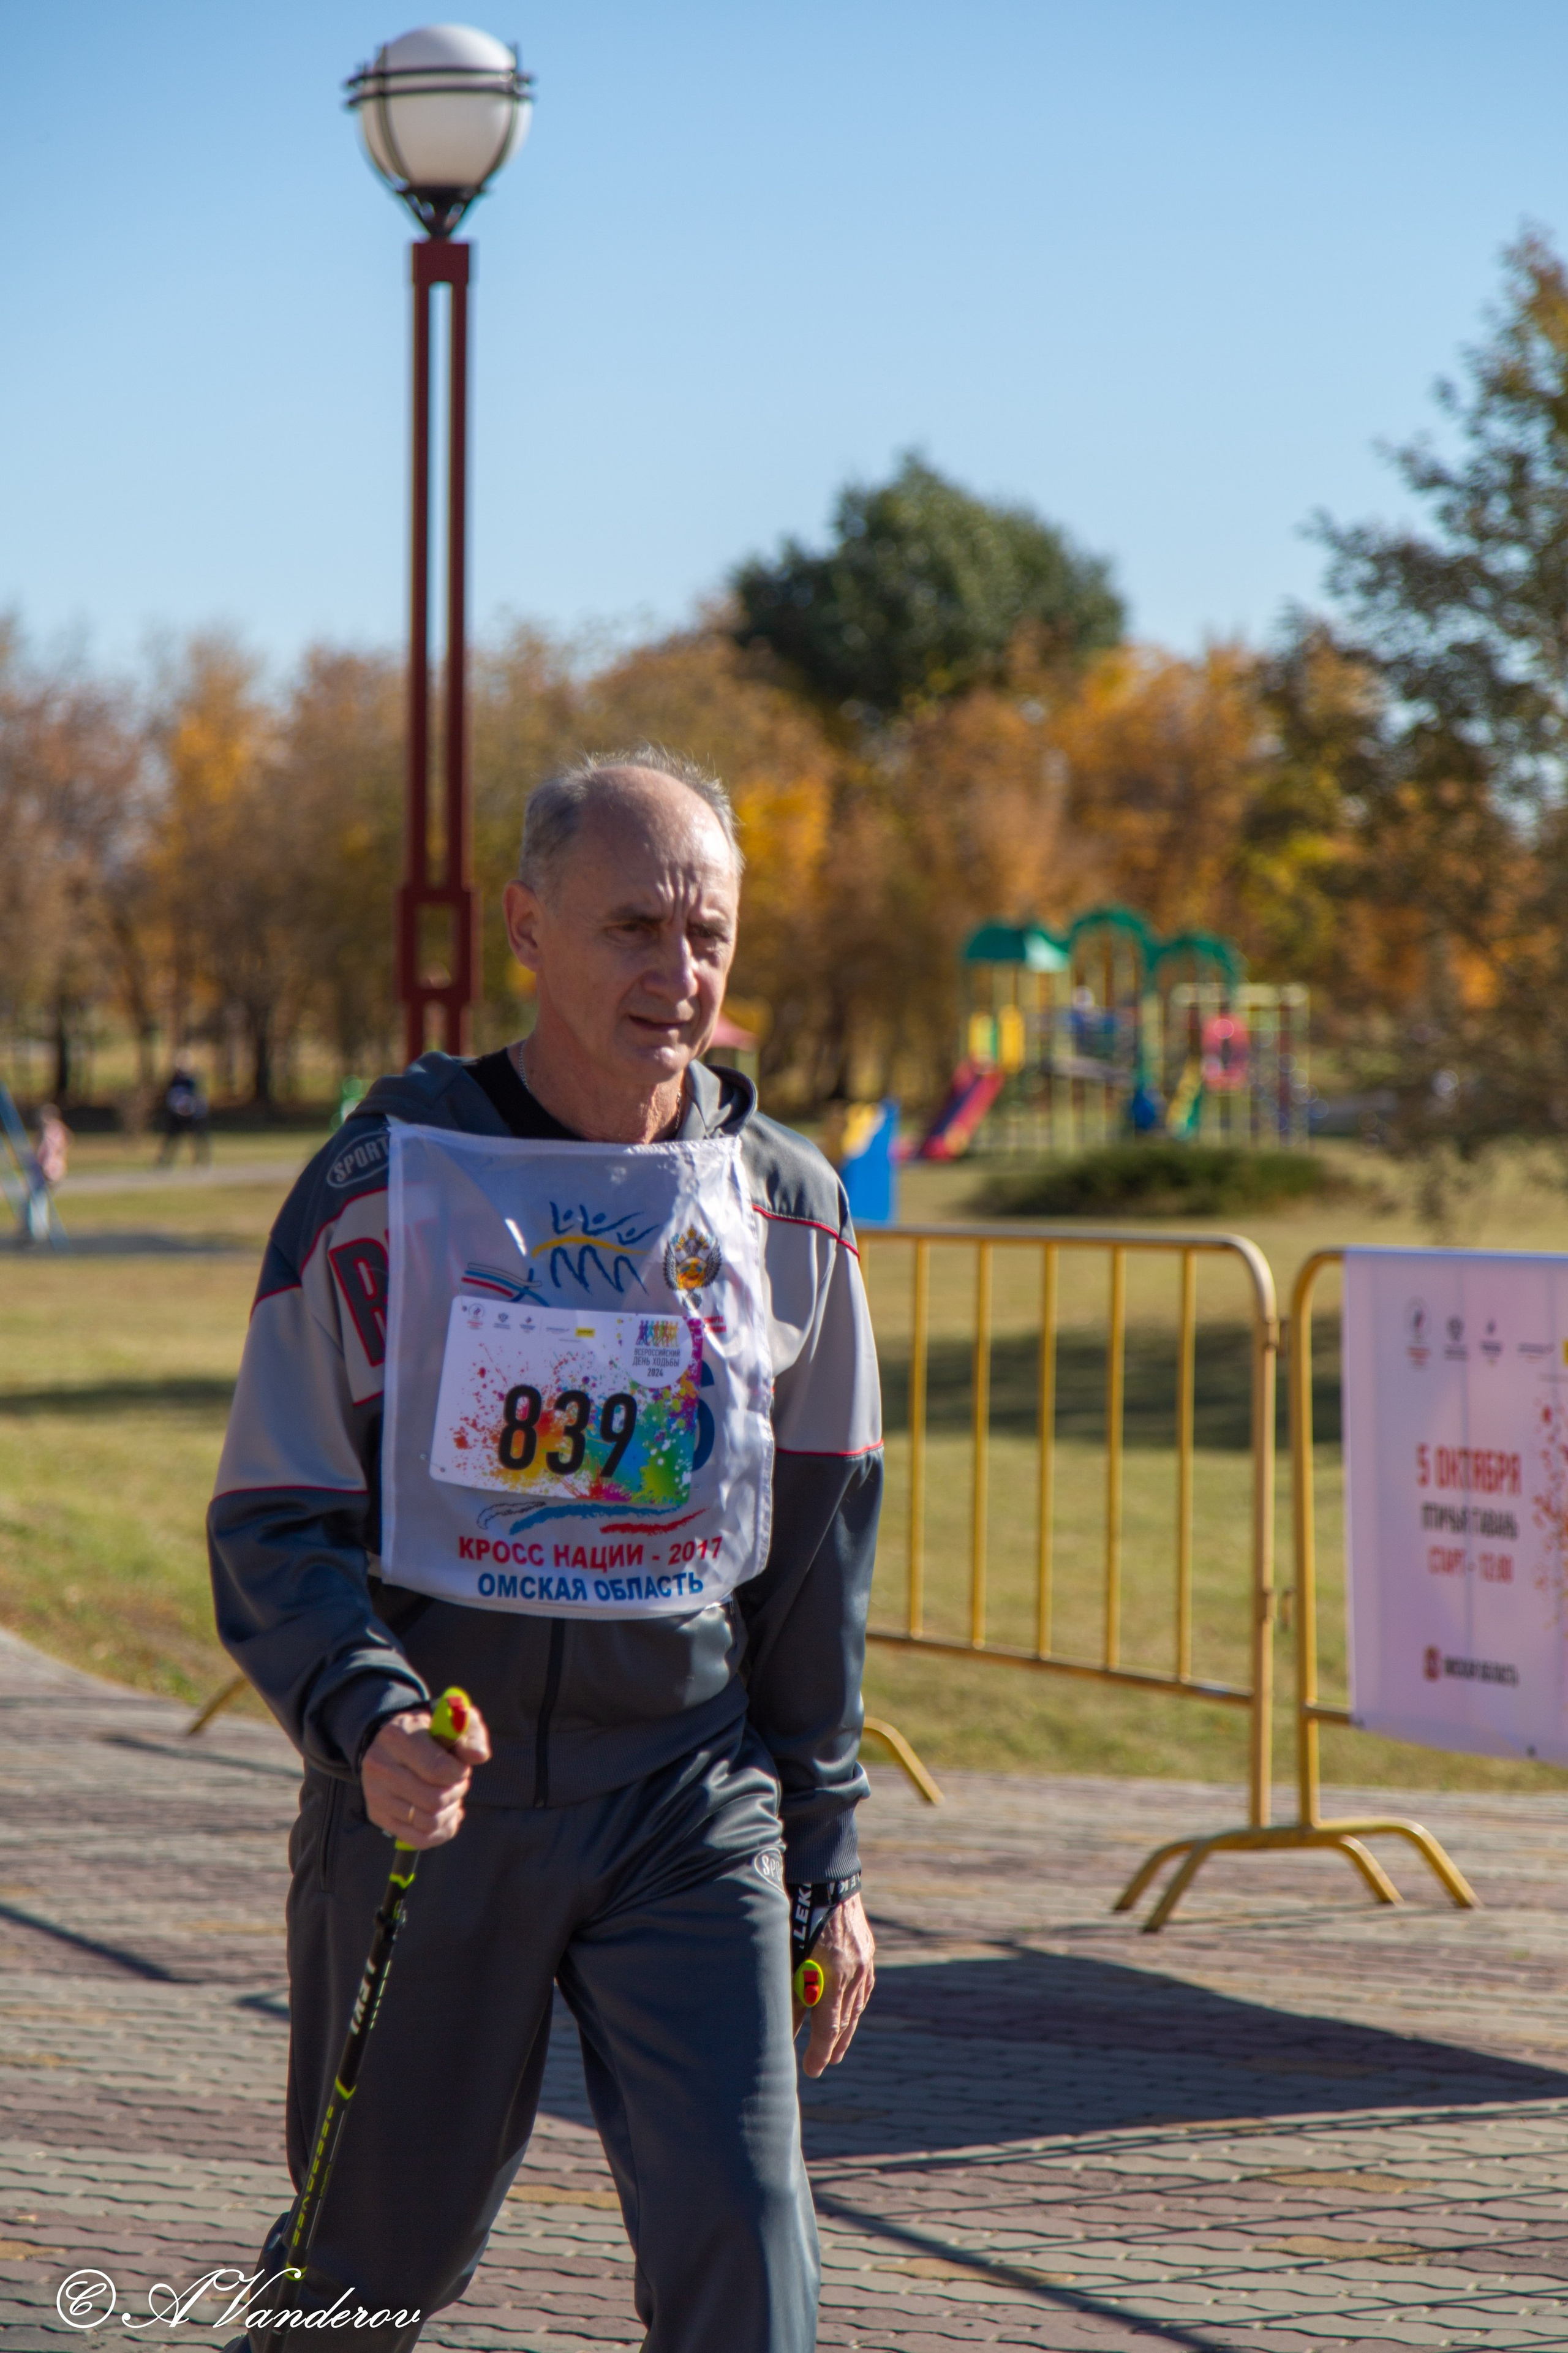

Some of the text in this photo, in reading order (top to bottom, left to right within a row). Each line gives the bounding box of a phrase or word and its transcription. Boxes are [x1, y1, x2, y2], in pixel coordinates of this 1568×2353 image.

[633, 1358, 680, 1367] ДЕНЬ ХОДЬБЫ
[634, 1348, 680, 1357] ВСЕРОССИЙСКИЙ
[647, 1368, 663, 1377] 2024
[498, 1384, 638, 1478] 839
[1416, 1443, 1521, 1495] 5 ОКТЯБРЯ
[459, 1536, 545, 1567] КРОСС
[554, 1543, 643, 1573] НАЦИИ
[668, 1536, 723, 1566] 2017
[478, 1571, 704, 1601] ОМСКАЯ ОБЛАСТЬ
